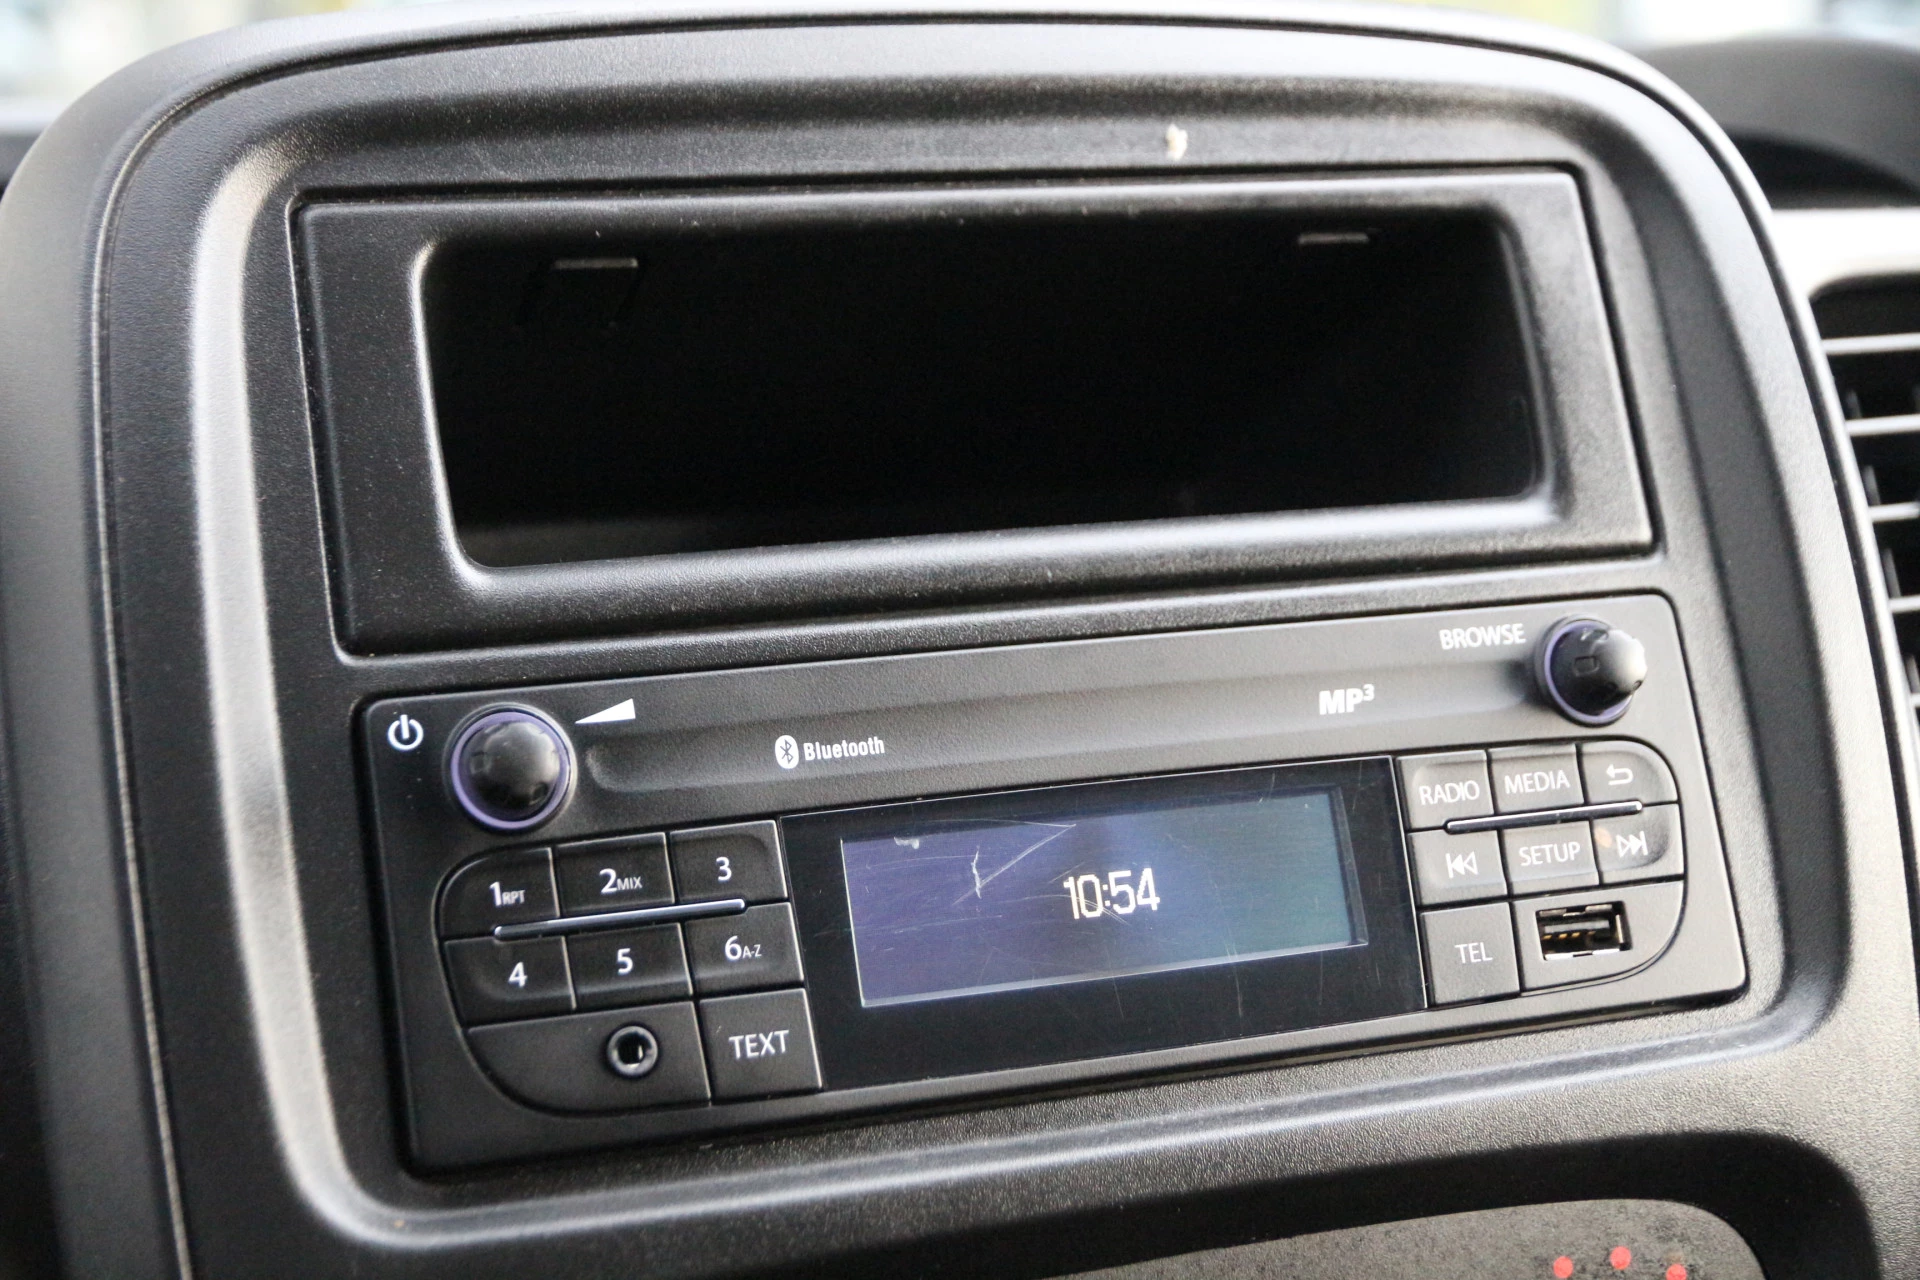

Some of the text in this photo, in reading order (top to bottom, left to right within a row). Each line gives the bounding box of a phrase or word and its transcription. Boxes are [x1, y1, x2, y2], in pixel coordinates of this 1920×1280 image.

[1439, 623, 1527, 650] BROWSE
[1318, 683, 1375, 716] MP3
[803, 736, 885, 762] Bluetooth
[1418, 779, 1480, 806] RADIO
[1503, 768, 1570, 795] MEDIA
[1518, 841, 1581, 867] SETUP
[716, 856, 732, 882] 3
[1063, 867, 1161, 920] 10:54
[616, 948, 634, 975] 5
[1455, 942, 1493, 965] TEL
[508, 961, 528, 988] 4
[728, 1030, 790, 1060] TEXT
